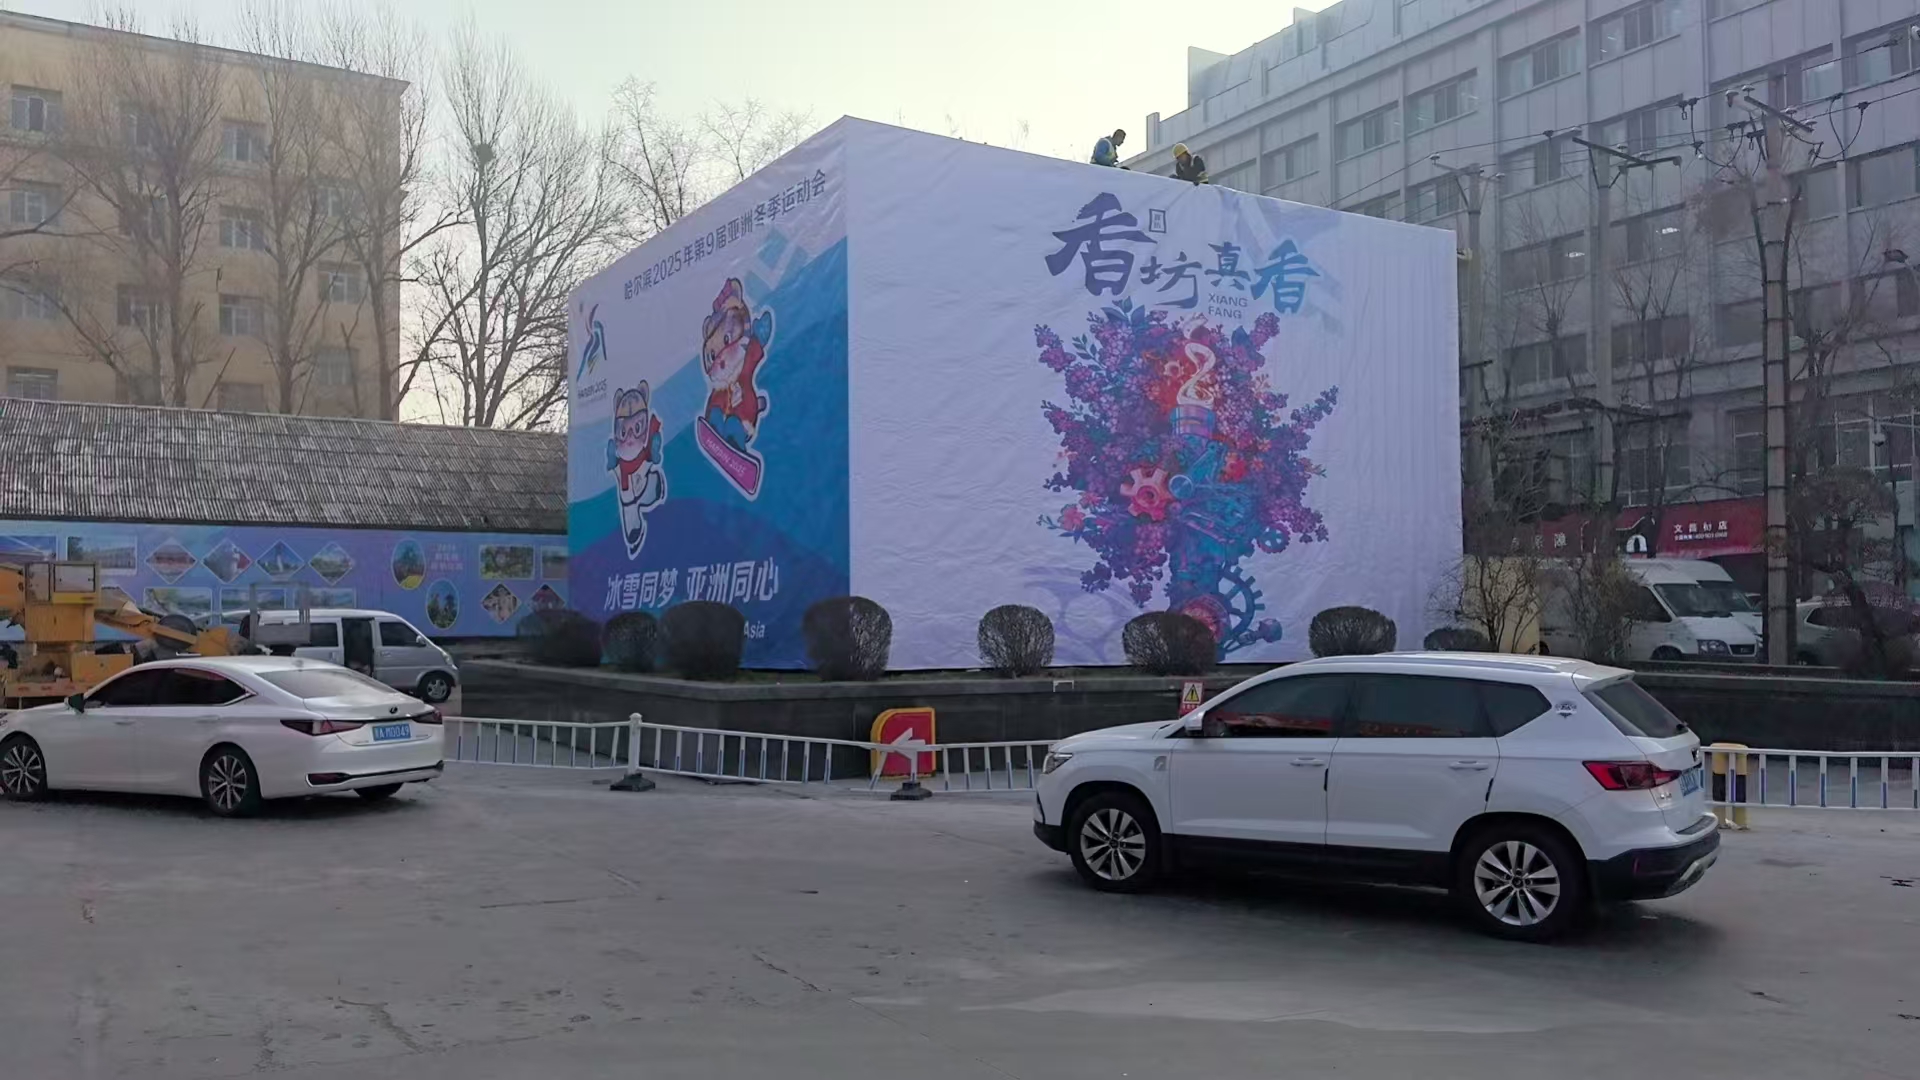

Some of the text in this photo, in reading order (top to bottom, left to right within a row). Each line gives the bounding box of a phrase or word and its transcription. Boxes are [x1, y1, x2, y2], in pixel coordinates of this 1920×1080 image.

[624, 169, 826, 300] 哈尔滨2025年第9届亚洲冬季运动会
[1045, 192, 1320, 314] 香坊真香
[1208, 293, 1248, 308] XIANG
[1208, 306, 1242, 320] FANG
[604, 556, 779, 612] 冰雪同梦 亚洲同心
[743, 620, 766, 639] Asia
